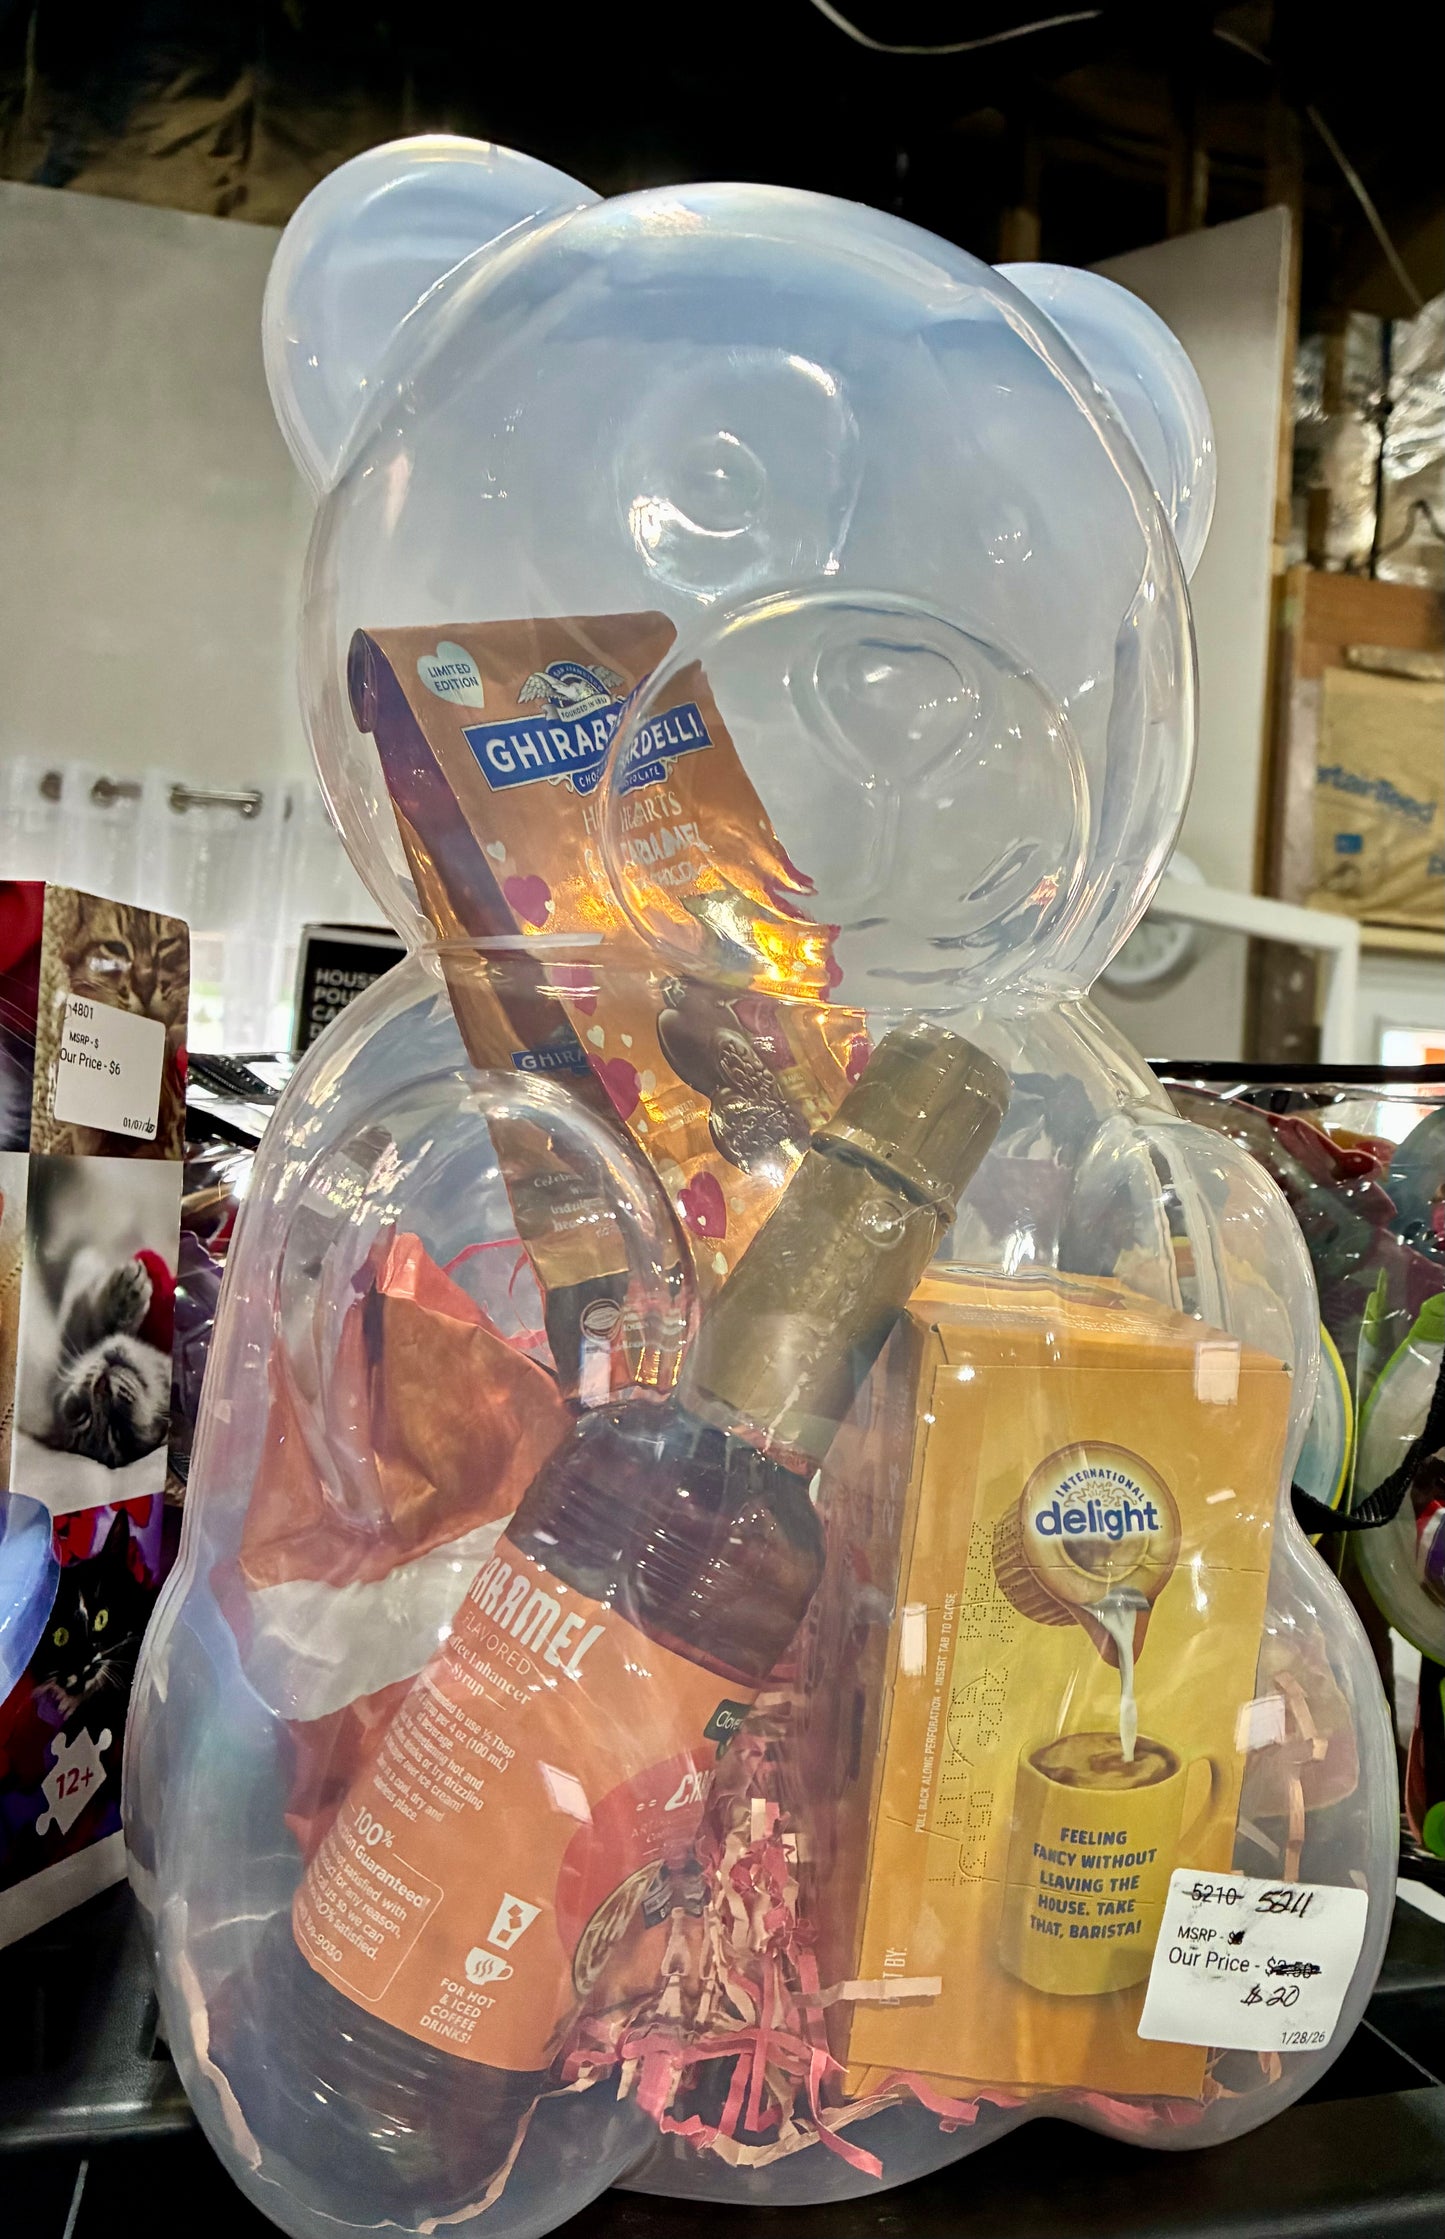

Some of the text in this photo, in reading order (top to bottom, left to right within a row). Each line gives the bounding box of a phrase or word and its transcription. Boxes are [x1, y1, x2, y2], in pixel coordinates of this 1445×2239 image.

[427, 663, 471, 678] LIMITED
[434, 676, 479, 692] EDITION
[72, 1002, 94, 1020] 4801
[69, 1030, 90, 1045] MSRP
[60, 1047, 77, 1064] Our
[78, 1052, 102, 1071] Price
[109, 1060, 121, 1075] $6
[1055, 1468, 1145, 1502] INTERNATIONAL
[1035, 1499, 1160, 1541] delight
[469, 1557, 606, 1678] ARAMEL
[942, 1623, 952, 1634] TO
[462, 1611, 532, 1676] FLAVORED
[939, 1635, 950, 1655] TAB
[451, 1662, 485, 1697] Syrup
[469, 1651, 532, 1705] Enhancer
[934, 1656, 947, 1686] INSERT
[976, 1667, 1008, 1747] 2026
[455, 1708, 465, 1721] to
[464, 1717, 482, 1735] use
[491, 1734, 516, 1759] Tbsp
[924, 1696, 941, 1754] PERFORATION
[455, 1730, 467, 1743] oz
[465, 1736, 489, 1758] (100
[487, 1753, 509, 1773] mL)
[56, 1766, 94, 1800] 12+
[421, 1758, 433, 1770] or
[431, 1764, 446, 1782] try
[443, 1775, 484, 1812] drizzling
[447, 1759, 465, 1777] hot
[462, 1772, 485, 1792] and
[921, 1756, 934, 1786] ALONG
[410, 1791, 427, 1810] dry
[424, 1805, 445, 1823] and
[418, 1771, 432, 1789] ice
[430, 1784, 465, 1813] cream!
[393, 1798, 418, 1823] place.
[354, 1806, 395, 1848] 100%
[1060, 1827, 1128, 1846] FEELING
[1033, 1843, 1157, 1869] FANCY WITHOUT
[343, 1863, 383, 1902] satisfied
[381, 1897, 408, 1922] with
[1040, 1870, 1140, 1893] LEAVING THE
[1191, 1883, 1237, 1906] 5210
[1038, 1894, 1136, 1916] HOUSE. TAKE
[336, 1898, 347, 1913] so
[347, 1909, 362, 1927] we
[363, 1924, 385, 1944] can
[362, 1903, 401, 1940] reason,
[1030, 1914, 1142, 1939] THAT, BARISTA!
[1177, 1925, 1217, 1943] MSRP
[333, 1918, 379, 1961] satisfied.
[1169, 1946, 1201, 1967] Our
[1205, 1951, 1250, 1973] Price
[439, 1993, 481, 2018] & ICED
[440, 1977, 496, 2009] FOR HOT
[420, 2014, 472, 2044] DRINKS!
[429, 2004, 477, 2032] COFFEE
[1281, 2031, 1326, 2045] 1/28/26
